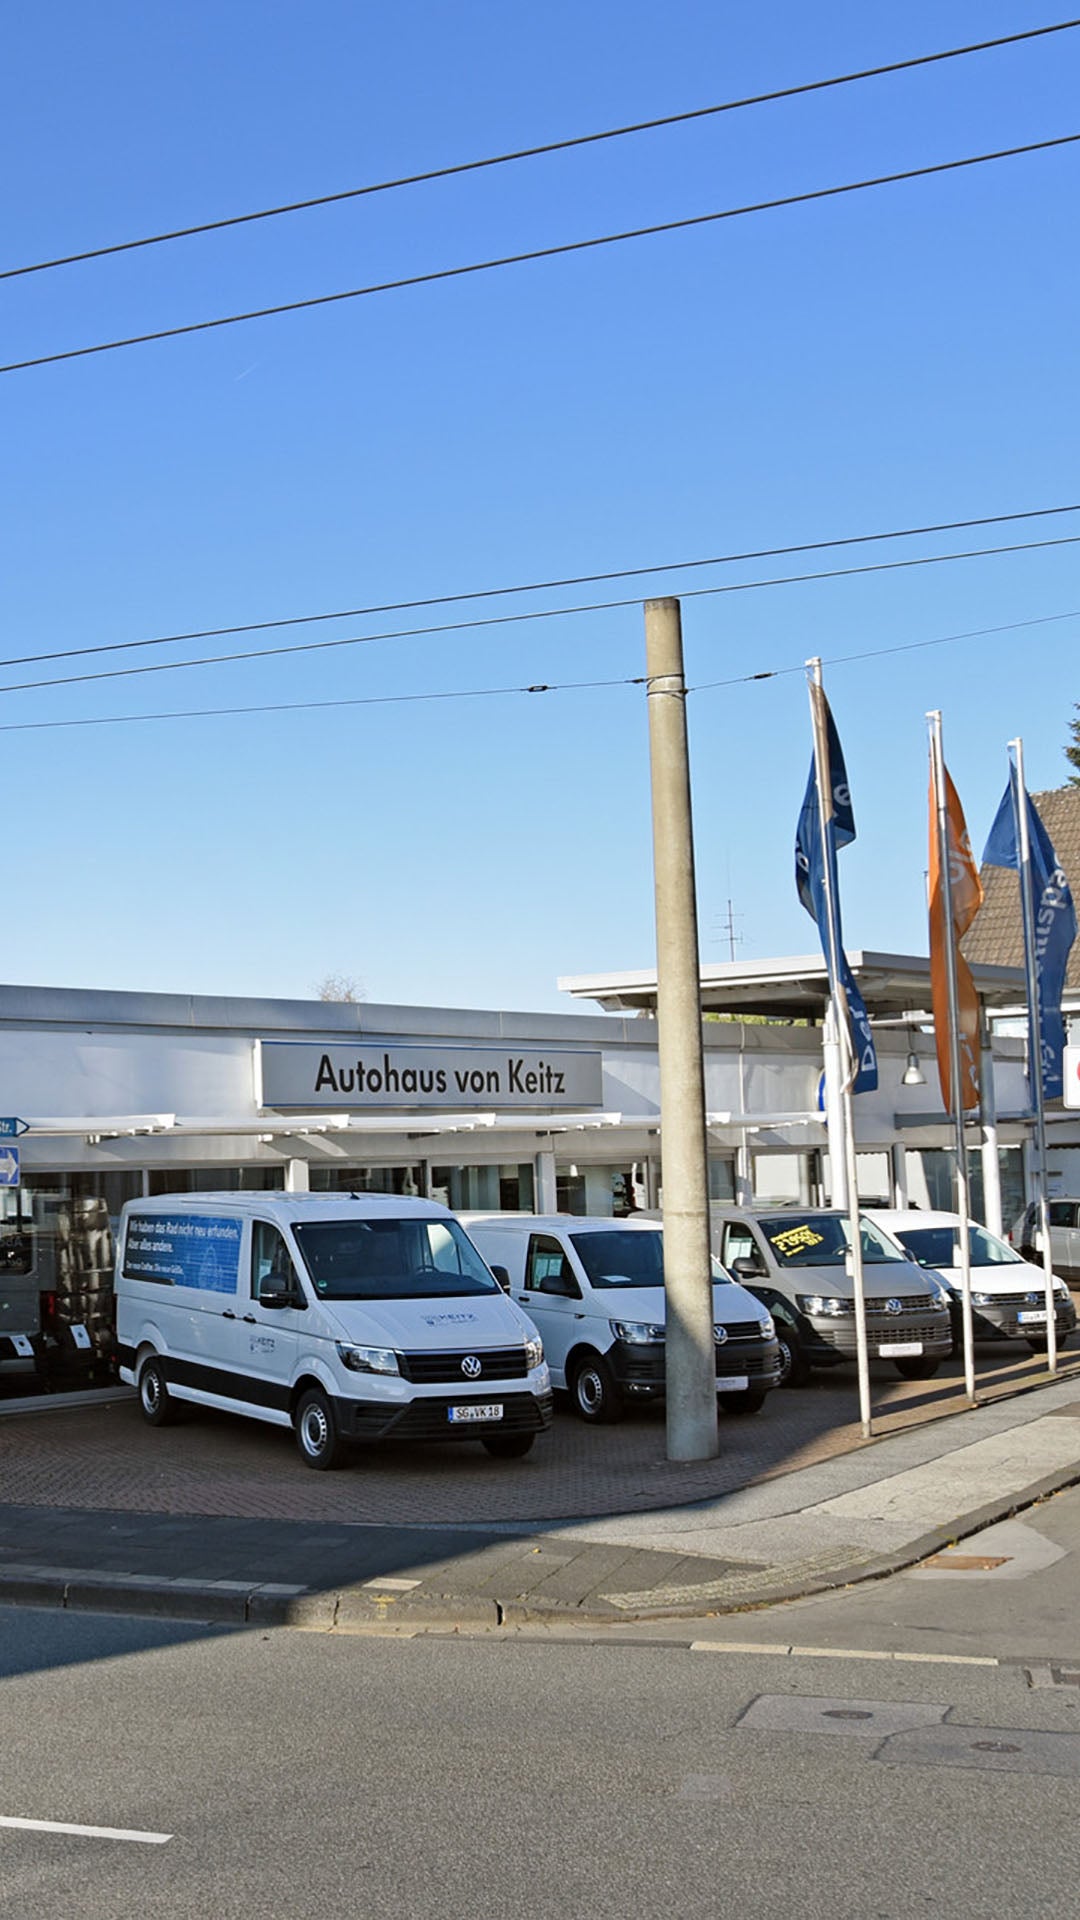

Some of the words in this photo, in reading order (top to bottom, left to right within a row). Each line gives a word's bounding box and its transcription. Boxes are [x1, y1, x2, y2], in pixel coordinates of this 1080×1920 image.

[315, 1054, 447, 1093] Autohaus
[454, 1069, 500, 1093] von
[508, 1058, 566, 1094] Keitz
[130, 1220, 138, 1231] Wir
[139, 1221, 154, 1233] haben
[155, 1221, 164, 1233] das
[166, 1221, 178, 1234] Rad
[178, 1222, 193, 1235] nicht
[195, 1226, 206, 1237] neu
[207, 1225, 239, 1238] erfunden.
[456, 1407, 469, 1418] SG
[474, 1407, 487, 1417] VK
[489, 1406, 500, 1417] 18
